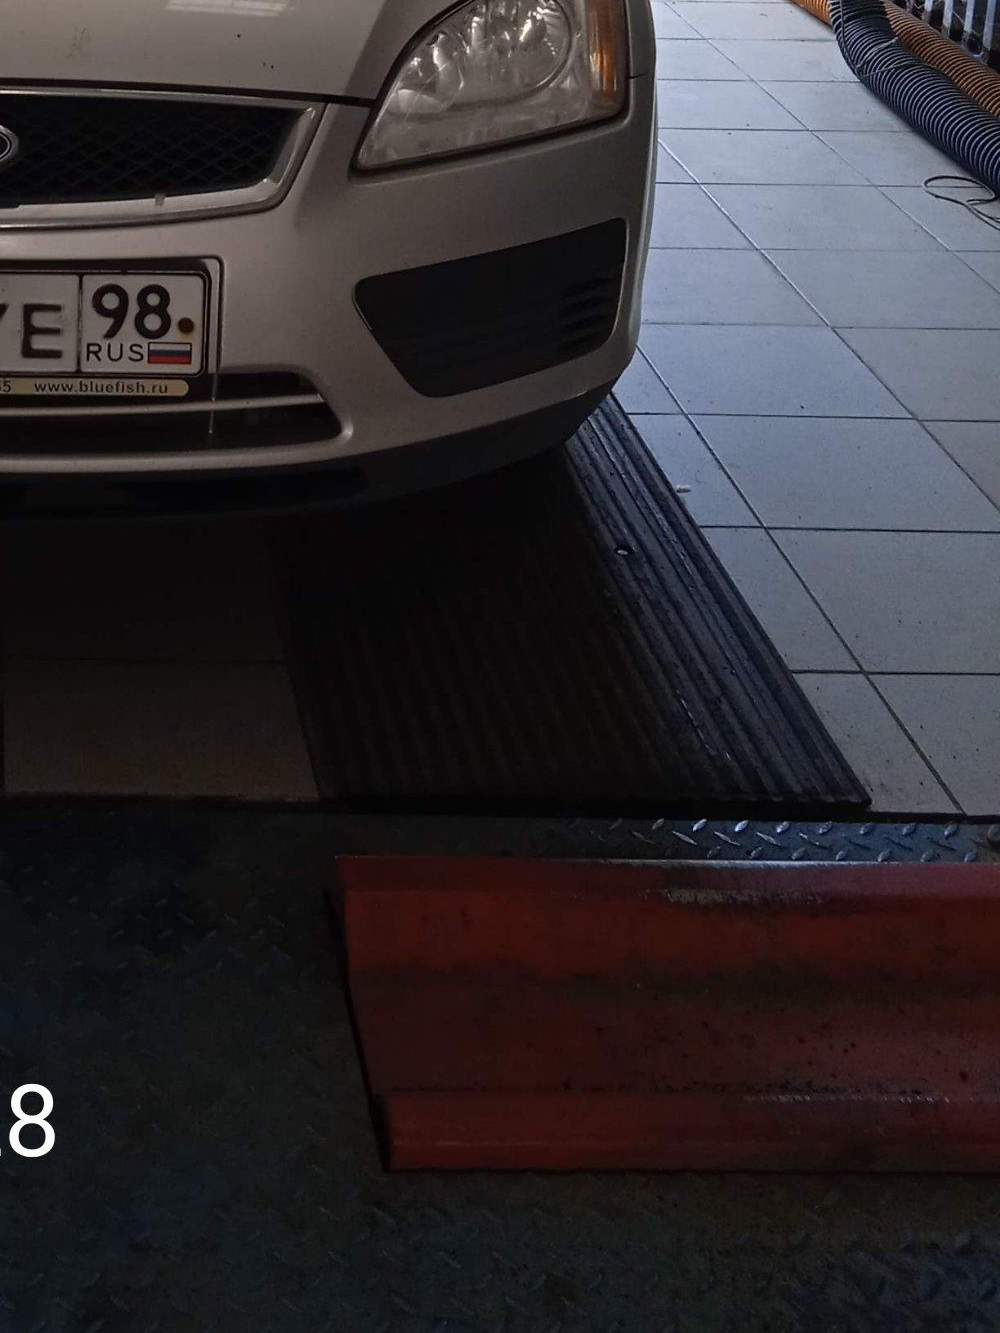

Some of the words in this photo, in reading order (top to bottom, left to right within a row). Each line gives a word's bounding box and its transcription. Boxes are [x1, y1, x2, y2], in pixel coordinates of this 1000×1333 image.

[92, 284, 171, 340] 98
[86, 342, 144, 362] RUS
[34, 379, 168, 394] www.bluefish.ru
